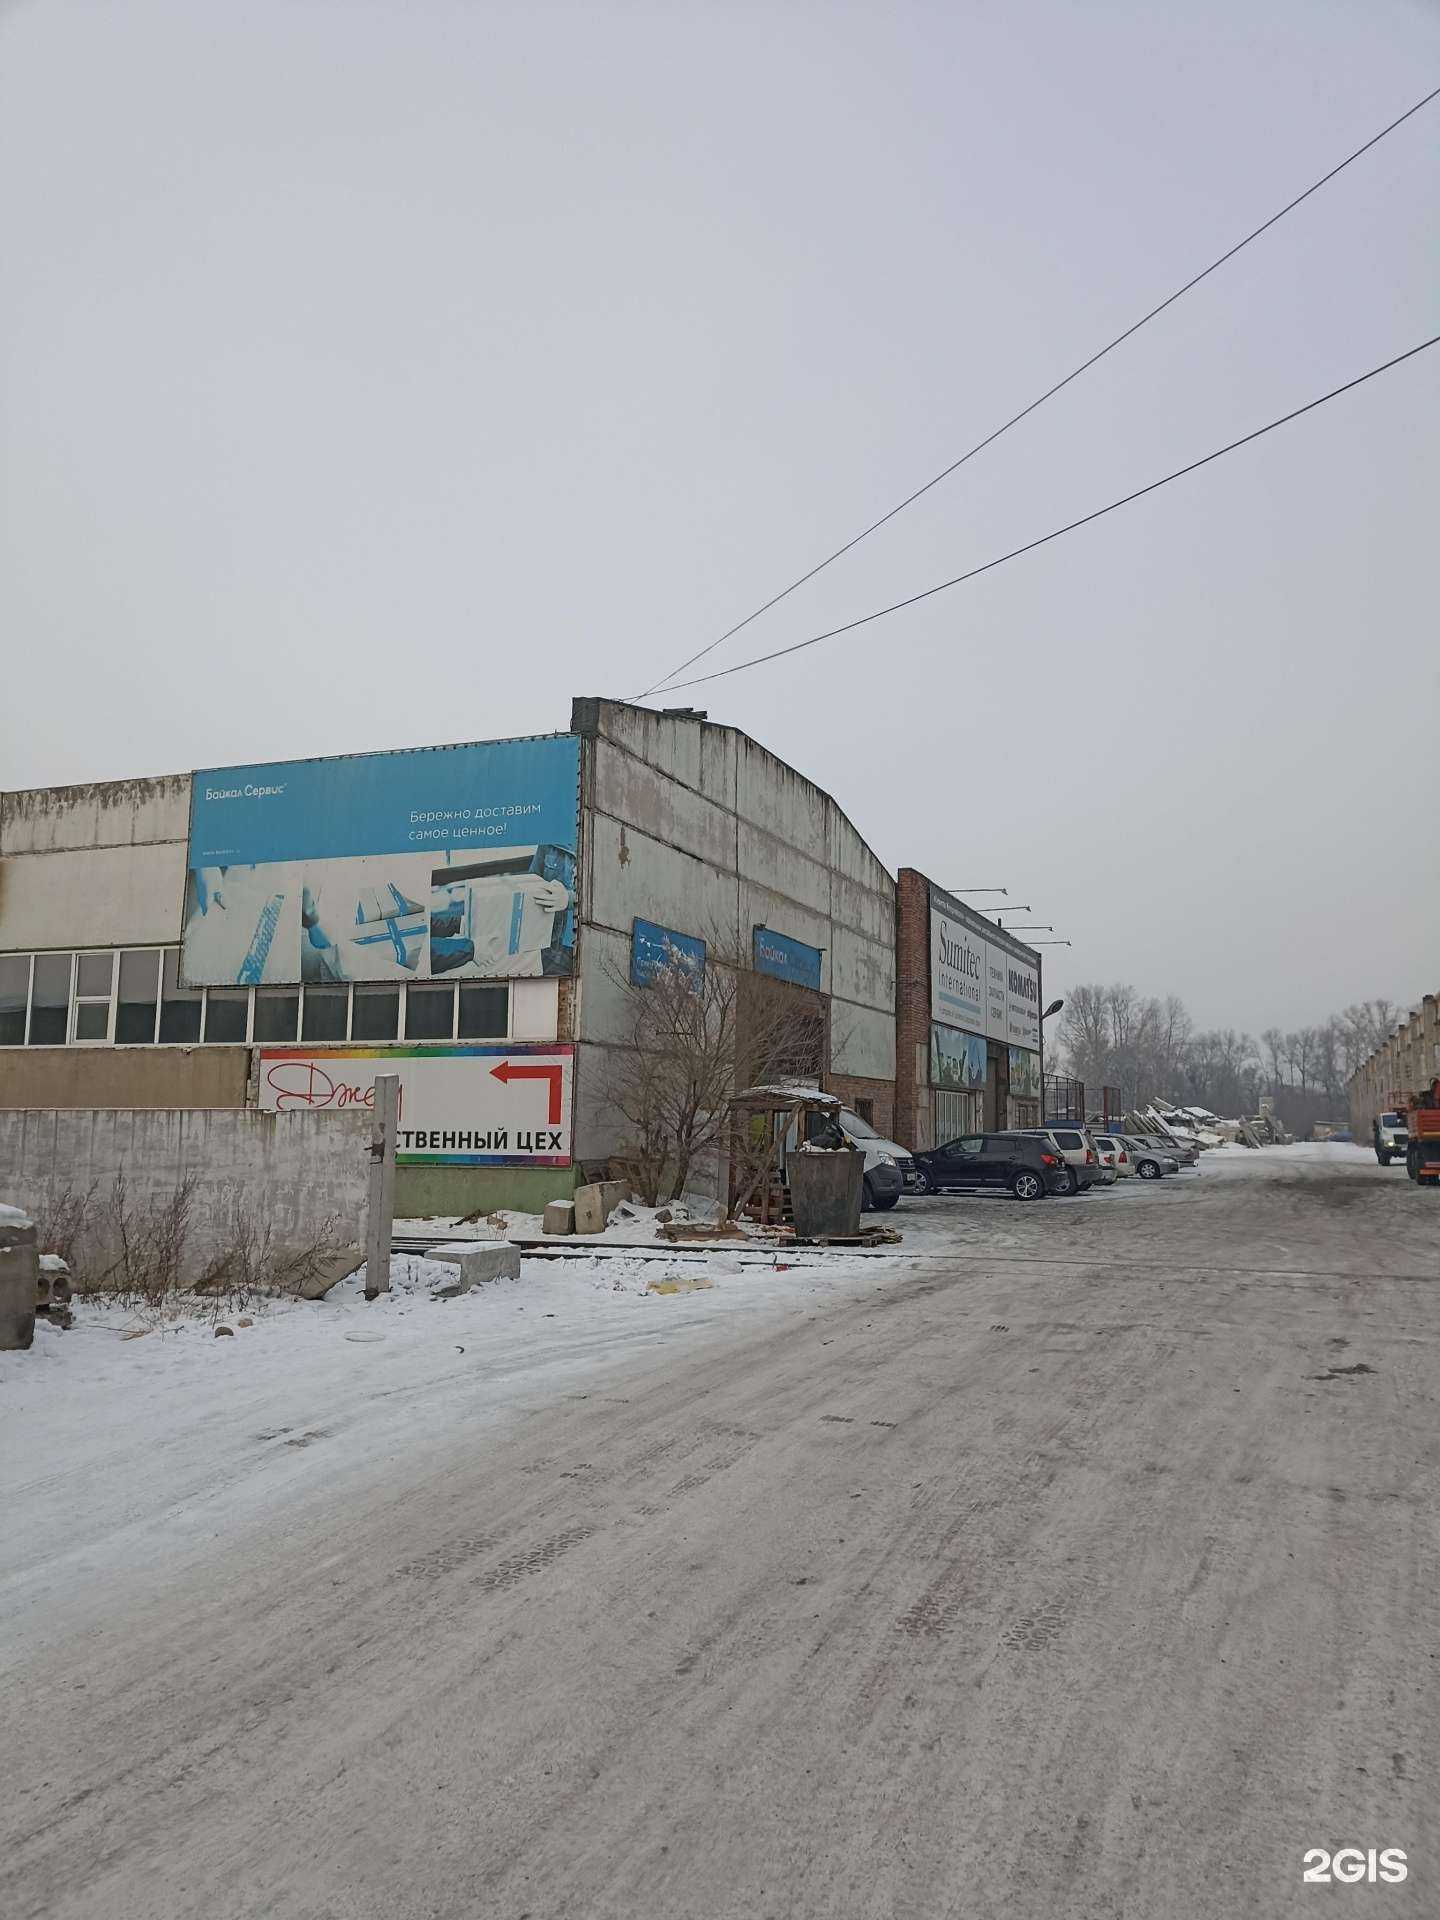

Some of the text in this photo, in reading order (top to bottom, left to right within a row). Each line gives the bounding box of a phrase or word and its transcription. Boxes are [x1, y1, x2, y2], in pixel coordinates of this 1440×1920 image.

[205, 783, 285, 801] Байкал Сервис
[409, 803, 541, 823] Бережно доставим
[408, 828, 449, 840] самое
[939, 920, 981, 980] Sumitec
[516, 1131, 563, 1154] ЦЕХ
